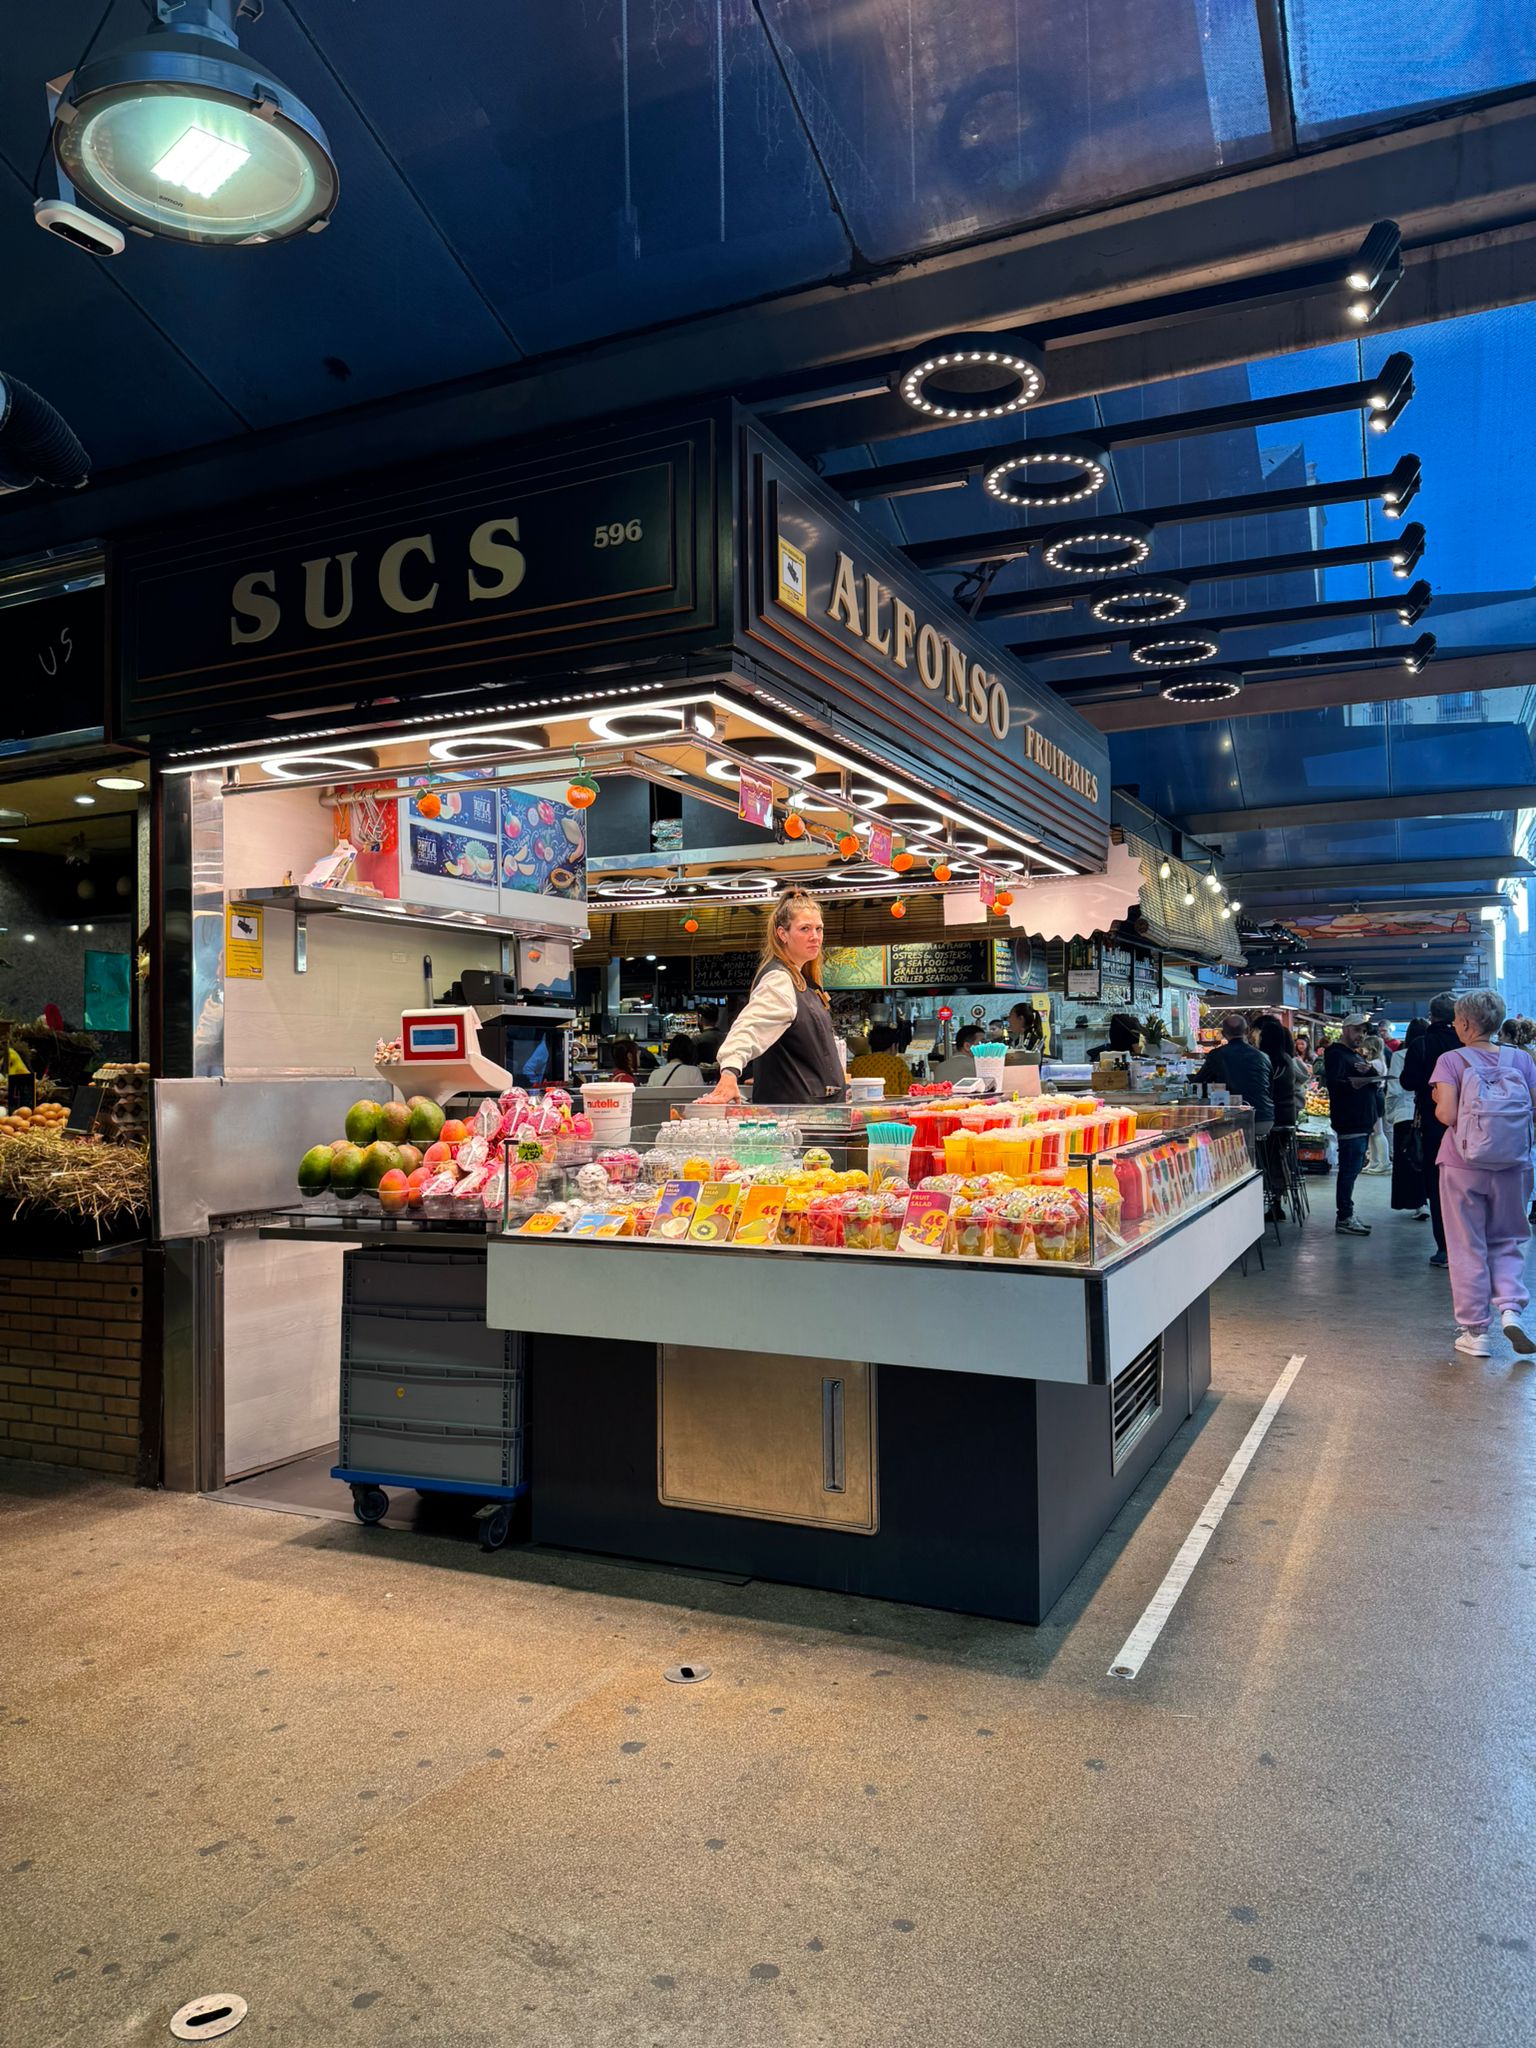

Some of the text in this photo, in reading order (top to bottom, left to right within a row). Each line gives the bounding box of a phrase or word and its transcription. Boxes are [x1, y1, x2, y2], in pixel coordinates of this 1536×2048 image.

[593, 518, 643, 549] 596
[230, 515, 527, 646] SUCS
[826, 550, 1010, 740] ALFONSO
[1023, 724, 1100, 804] FRUITERIES
[893, 974, 924, 983] GRILLED
[925, 973, 958, 983] SEAFOOD
[587, 1098, 620, 1109] nutella
[675, 1202, 692, 1212] 4€
[715, 1204, 732, 1215] 4€
[762, 1205, 779, 1216] 4€
[925, 1215, 944, 1226] 4€
